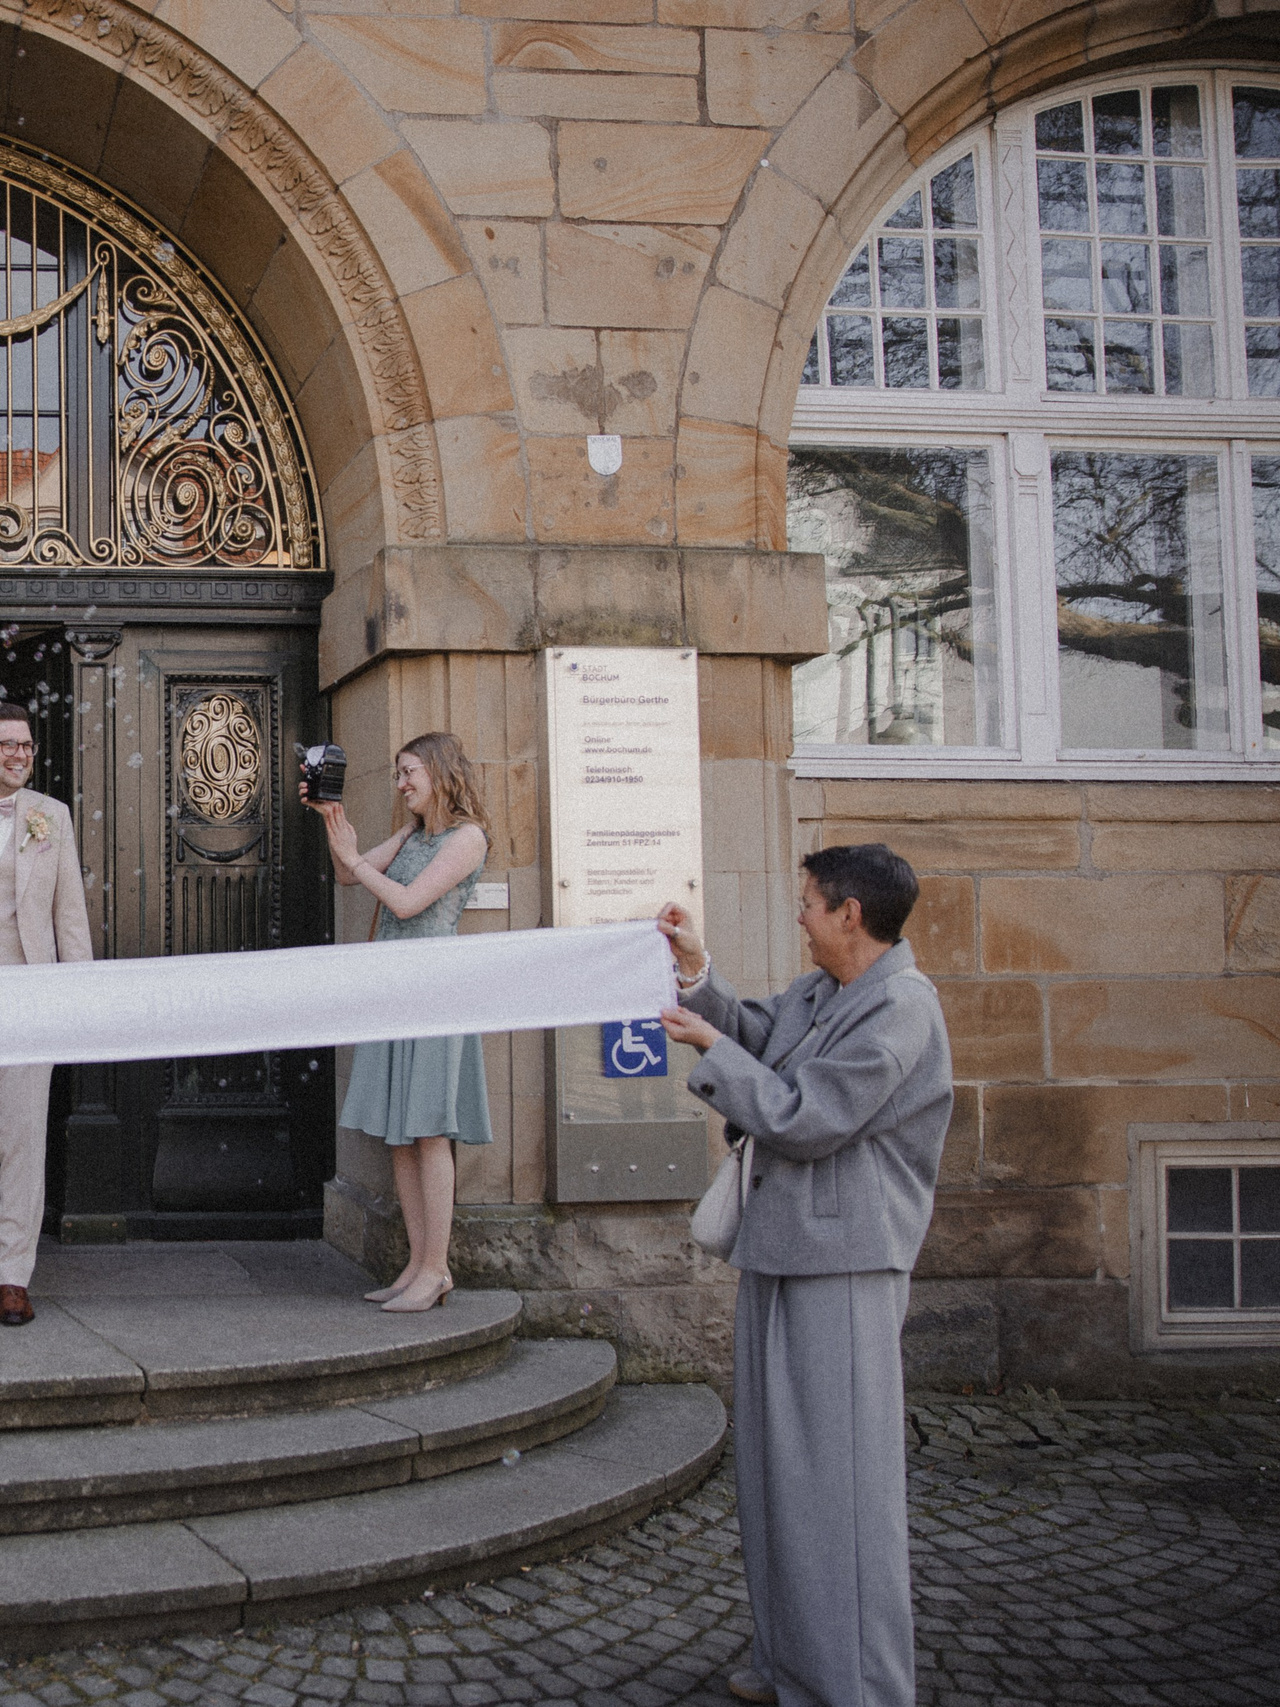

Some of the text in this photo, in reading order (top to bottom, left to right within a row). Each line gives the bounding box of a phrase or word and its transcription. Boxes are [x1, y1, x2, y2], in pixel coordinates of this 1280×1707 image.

[583, 695, 669, 705] Bürgerbüro Gerthe
[587, 839, 620, 847] Zentrum
